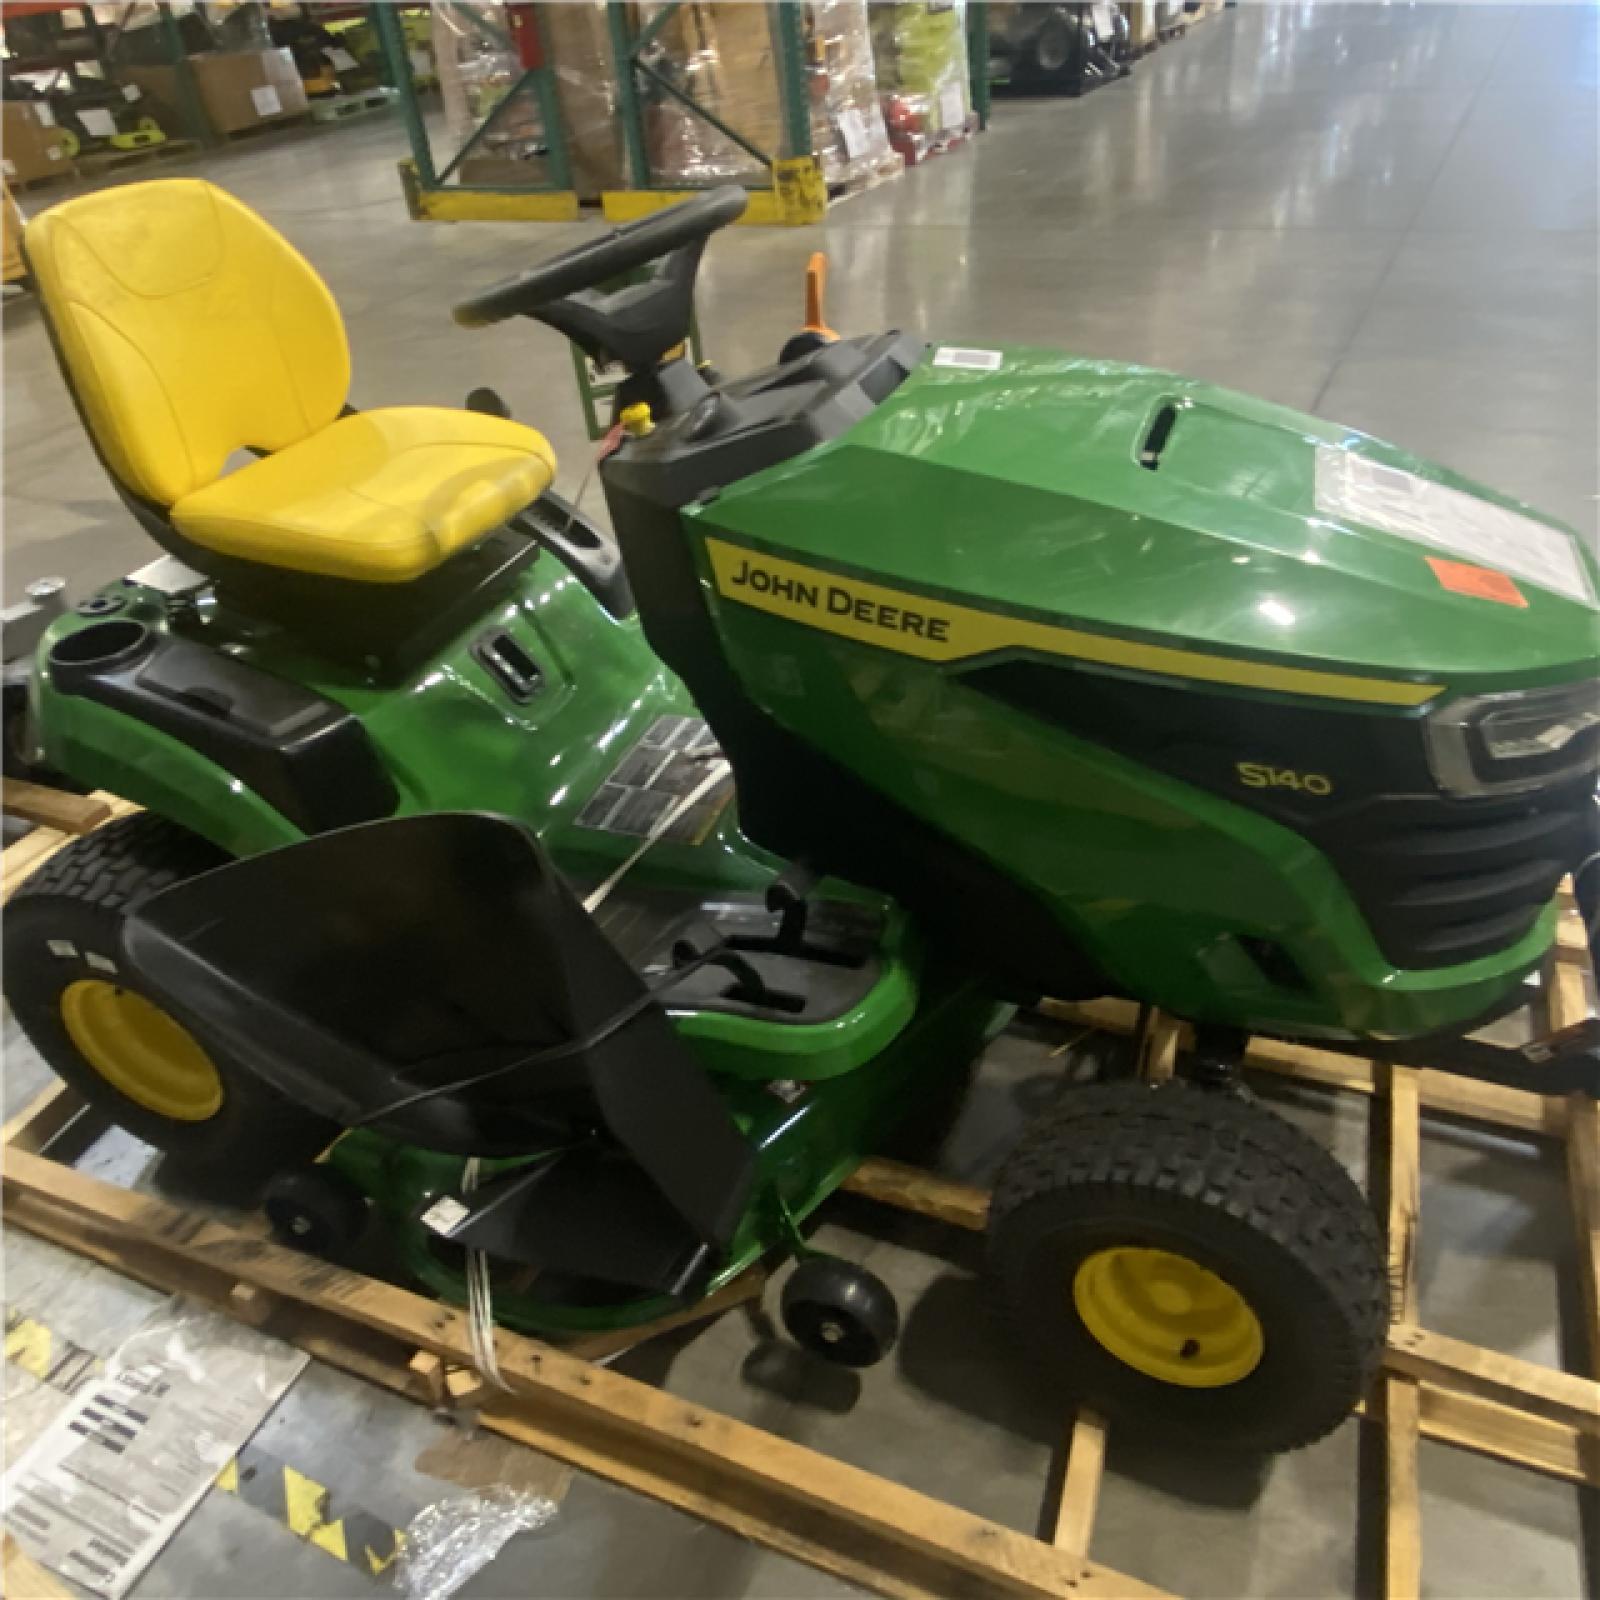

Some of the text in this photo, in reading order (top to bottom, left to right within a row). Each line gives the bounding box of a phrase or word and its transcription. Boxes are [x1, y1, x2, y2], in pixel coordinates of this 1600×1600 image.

[731, 560, 951, 642] JOHN DEERE
[1236, 761, 1332, 796] S140
